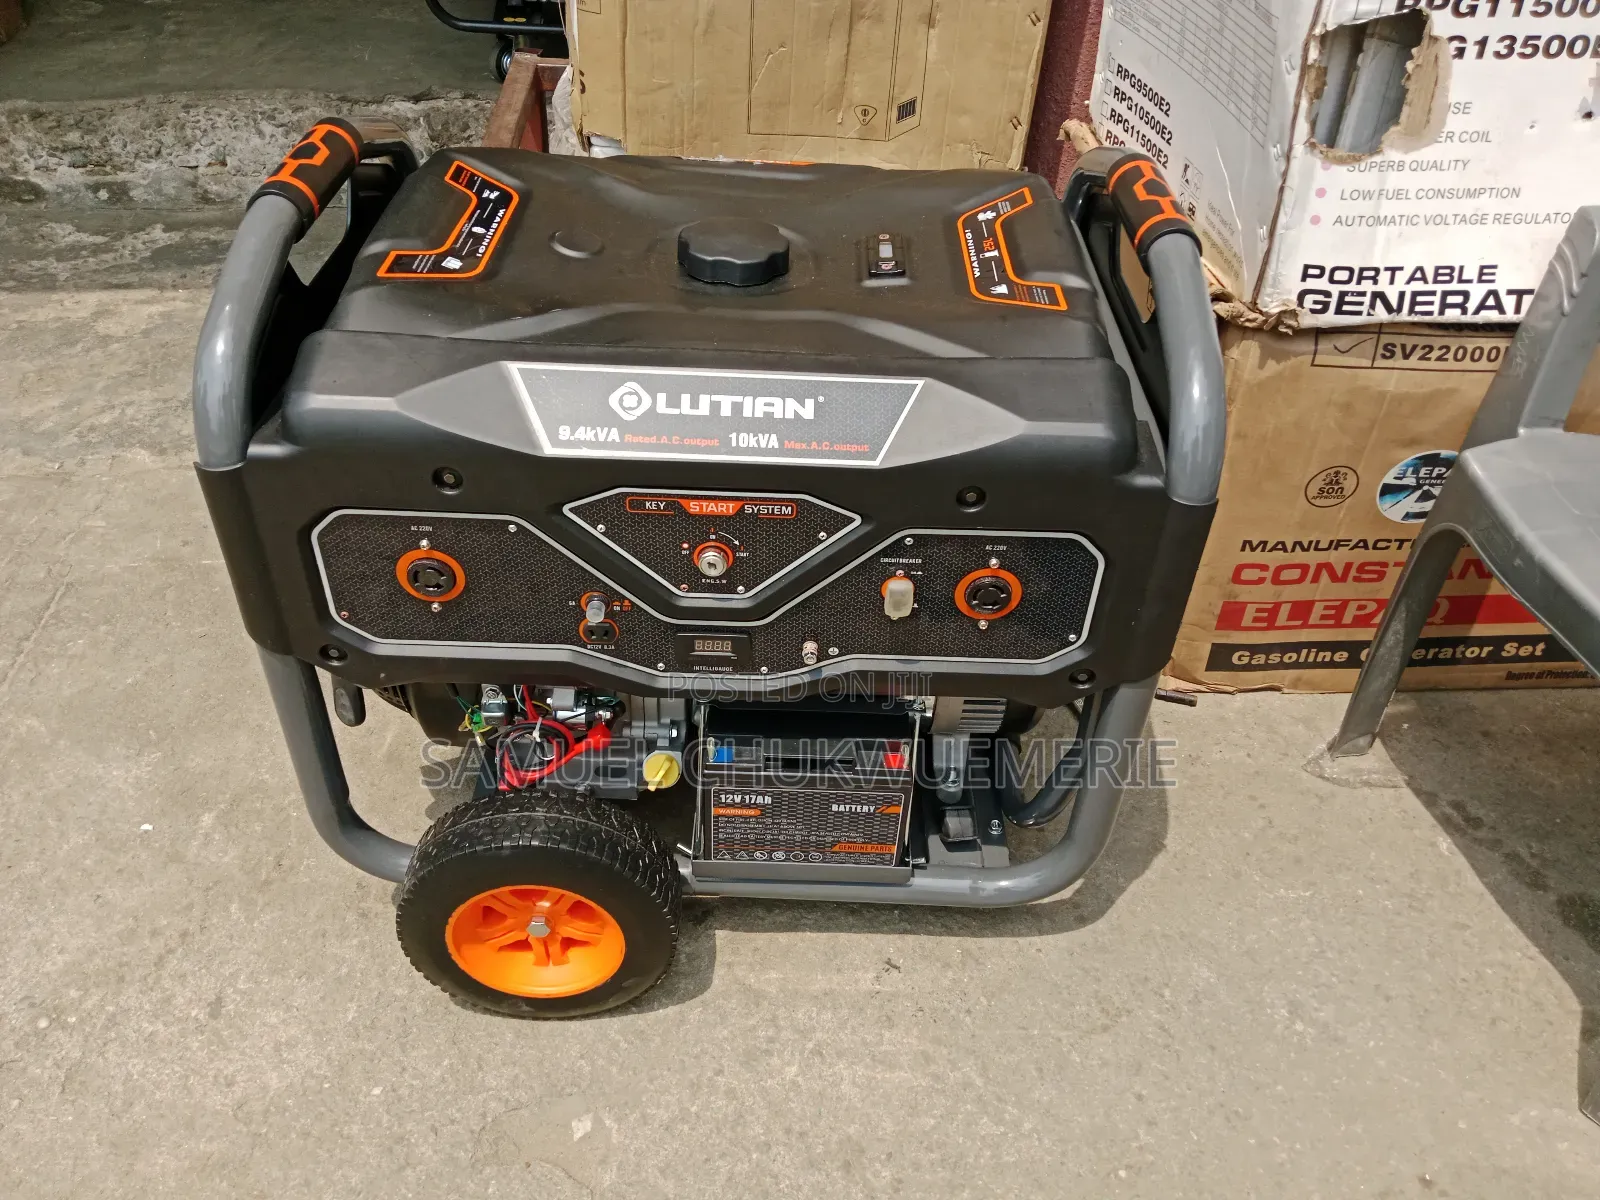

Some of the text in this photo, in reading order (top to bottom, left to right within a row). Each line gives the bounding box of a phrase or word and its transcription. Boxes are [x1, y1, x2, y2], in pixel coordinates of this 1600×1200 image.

[1116, 63, 1171, 118] RPG9500E2
[1113, 85, 1173, 147] RPG10500E2
[1450, 102, 1472, 115] SE
[1109, 107, 1169, 170] RPG11500E2
[1458, 131, 1492, 144] COIL
[1347, 159, 1471, 173] SUPERB QUALITY
[1340, 187, 1521, 201] LOW FUEL CONSUMPTION
[1333, 212, 1576, 227] AUTOMATIC VOLTAGE REGULATO
[476, 208, 506, 257] WARNING!
[965, 229, 981, 278] WARNING!
[1300, 264, 1498, 285] PORTABLE
[1380, 342, 1511, 363] SV22000
[656, 392, 815, 420] LUTIAN
[558, 425, 620, 443] 9.4kVA
[728, 432, 779, 449] 10kVA
[645, 501, 792, 515] KEY START SYSTEM
[1240, 598, 1450, 627] ELEPQ
[1231, 642, 1546, 665] Gasoline erator Set
[1505, 671, 1536, 681] Degree
[719, 793, 772, 805] 12V 17Ah
[718, 808, 755, 816] WARNING
[831, 804, 876, 813] BATTERY
[838, 844, 893, 853] GENUINE PARTS
